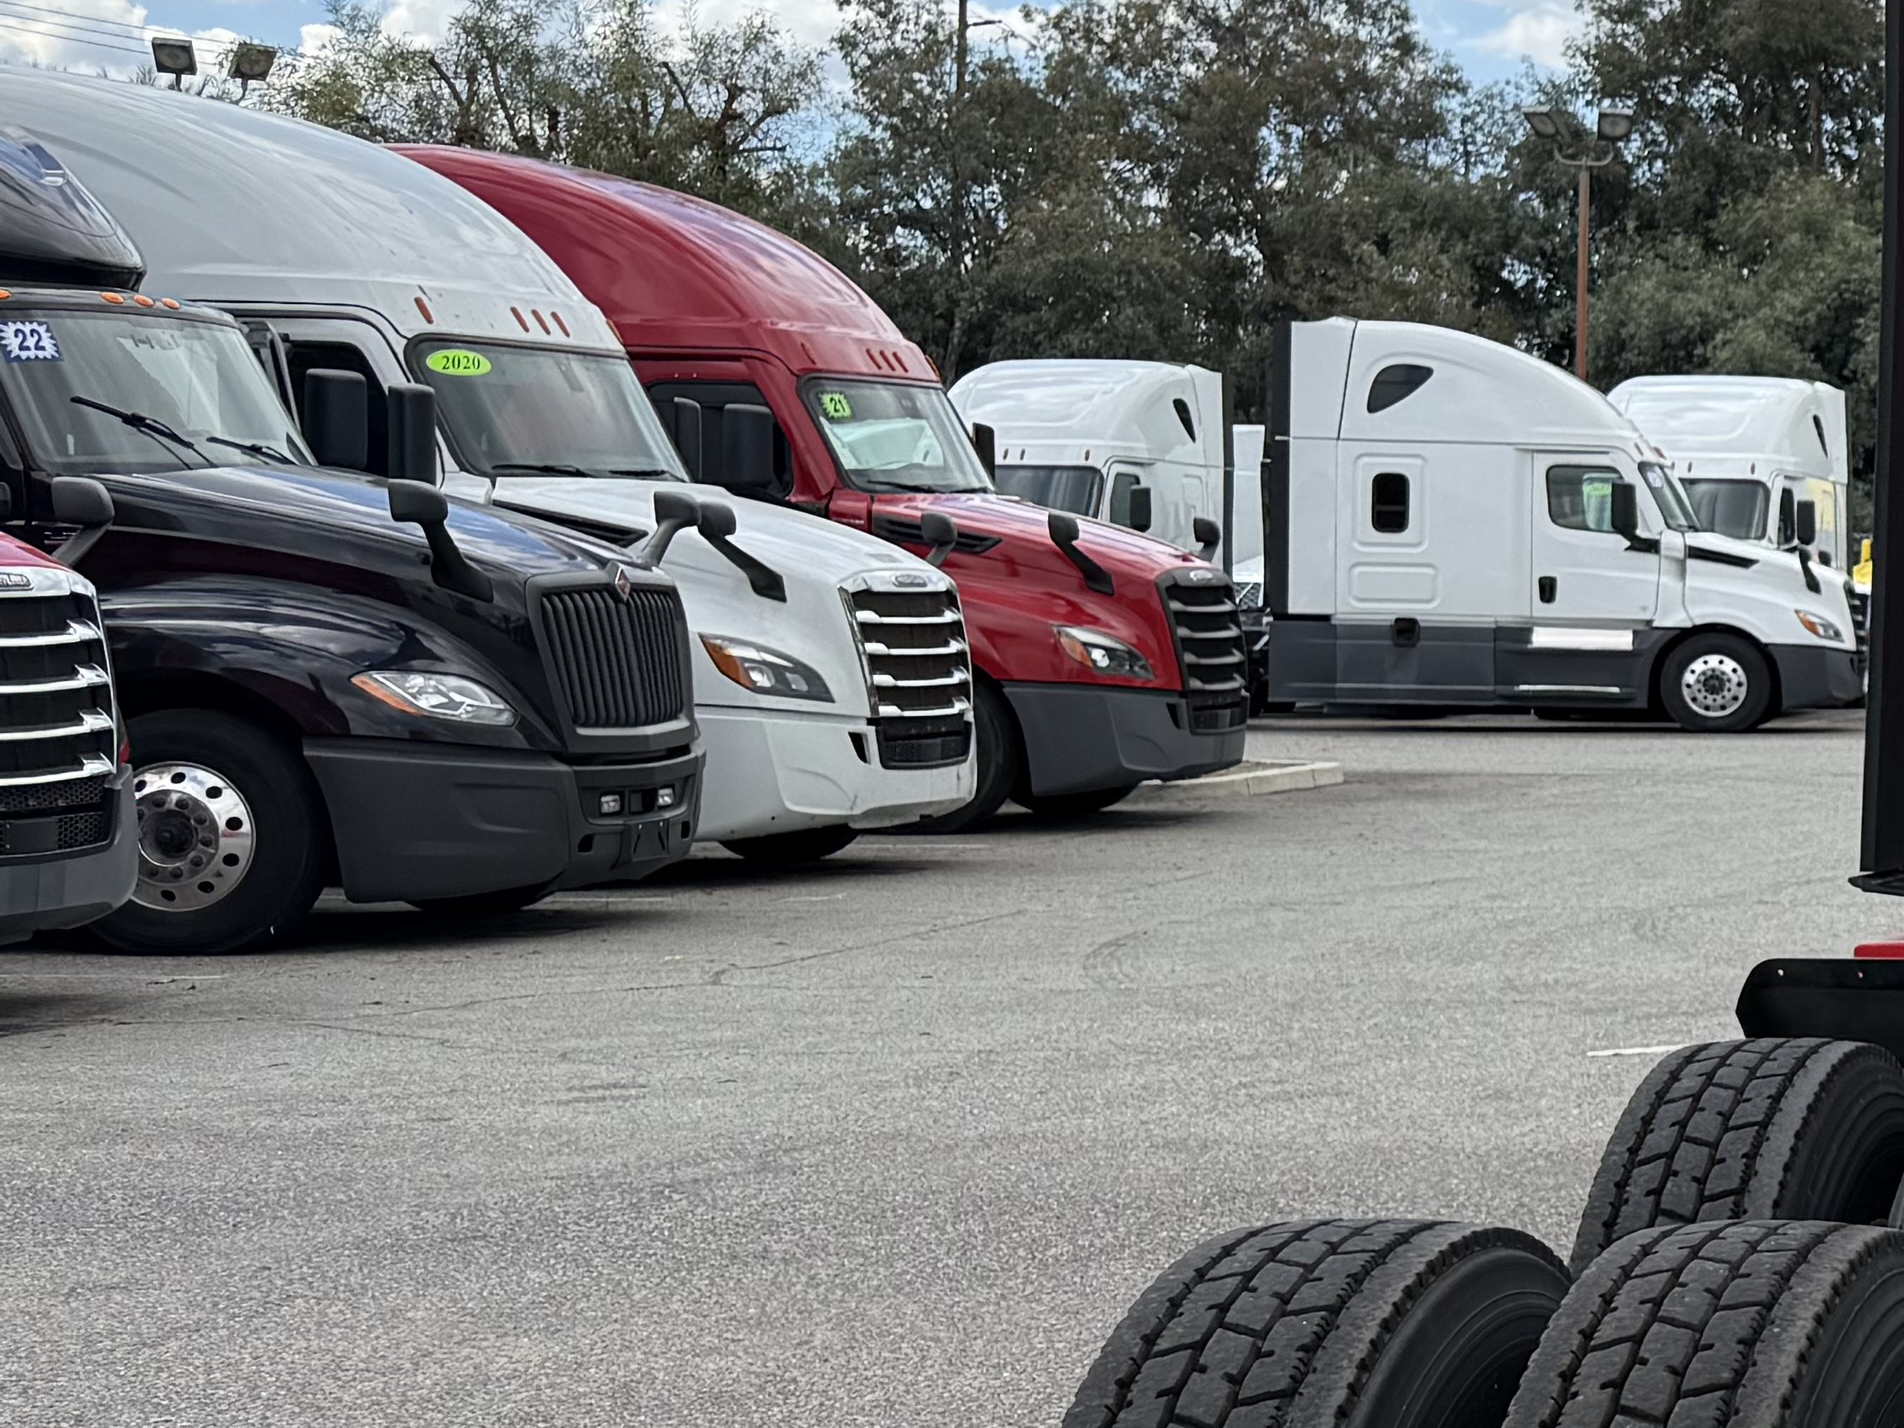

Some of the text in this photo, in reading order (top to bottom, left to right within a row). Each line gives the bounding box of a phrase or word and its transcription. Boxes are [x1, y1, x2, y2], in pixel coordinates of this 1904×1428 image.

[13, 328, 47, 352] 22
[441, 355, 481, 370] 2020
[829, 396, 846, 413] 21
